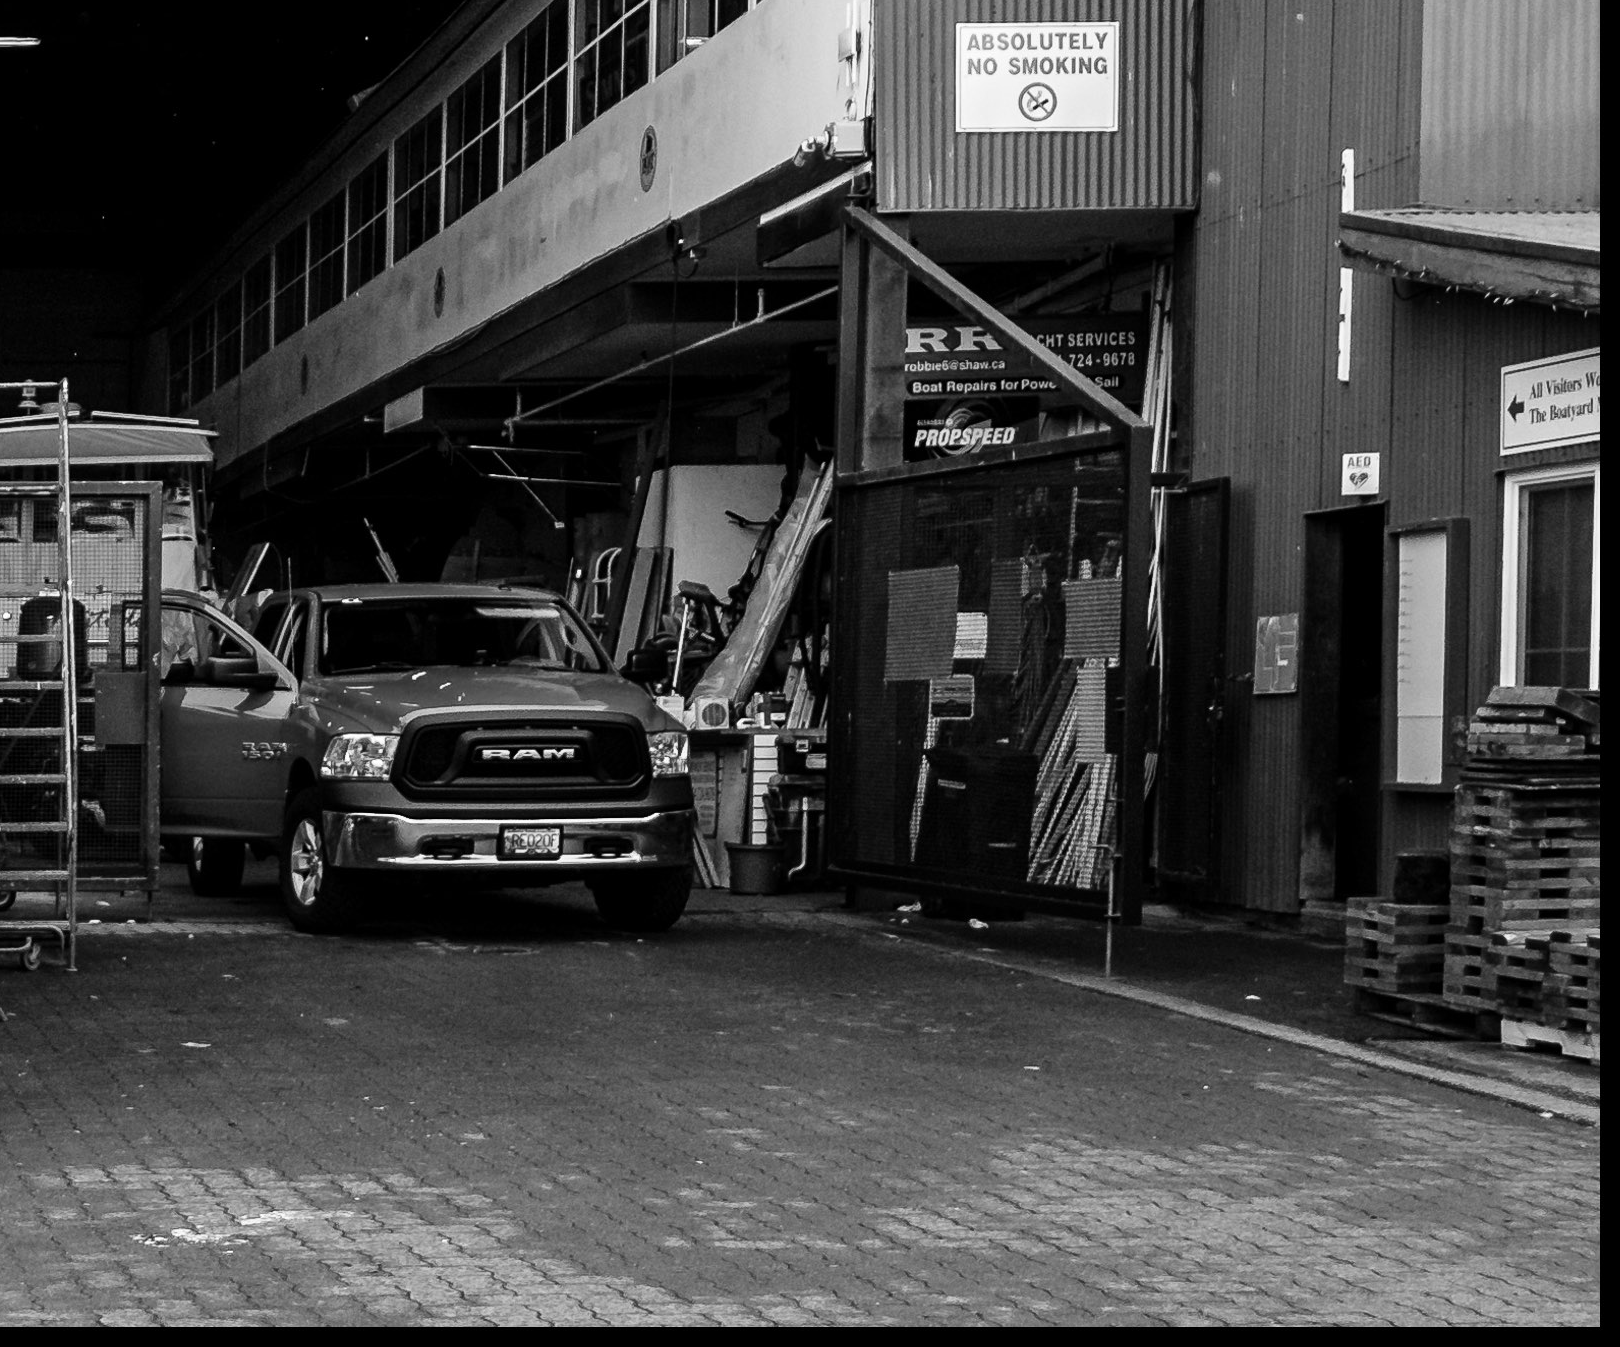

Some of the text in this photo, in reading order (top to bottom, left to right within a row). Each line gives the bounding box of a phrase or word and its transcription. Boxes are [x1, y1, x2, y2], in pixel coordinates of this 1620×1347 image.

[967, 32, 1108, 51] ABSOLUTELY
[967, 57, 1108, 75] NO SMOKING
[1031, 331, 1135, 348] CHT SERVICES
[904, 359, 1006, 372] robbie6@shaw.ca
[912, 381, 943, 393] Boat
[946, 379, 997, 395] Repairs
[1000, 379, 1019, 390] for
[1094, 375, 1119, 387] Sail
[1529, 381, 1543, 399] All
[1546, 377, 1582, 395] Visitors
[1529, 407, 1547, 424] The
[1549, 397, 1593, 422] Boatyard
[914, 426, 1016, 447] PROPSPEED
[1347, 456, 1371, 468] AED
[481, 748, 575, 760] RAM
